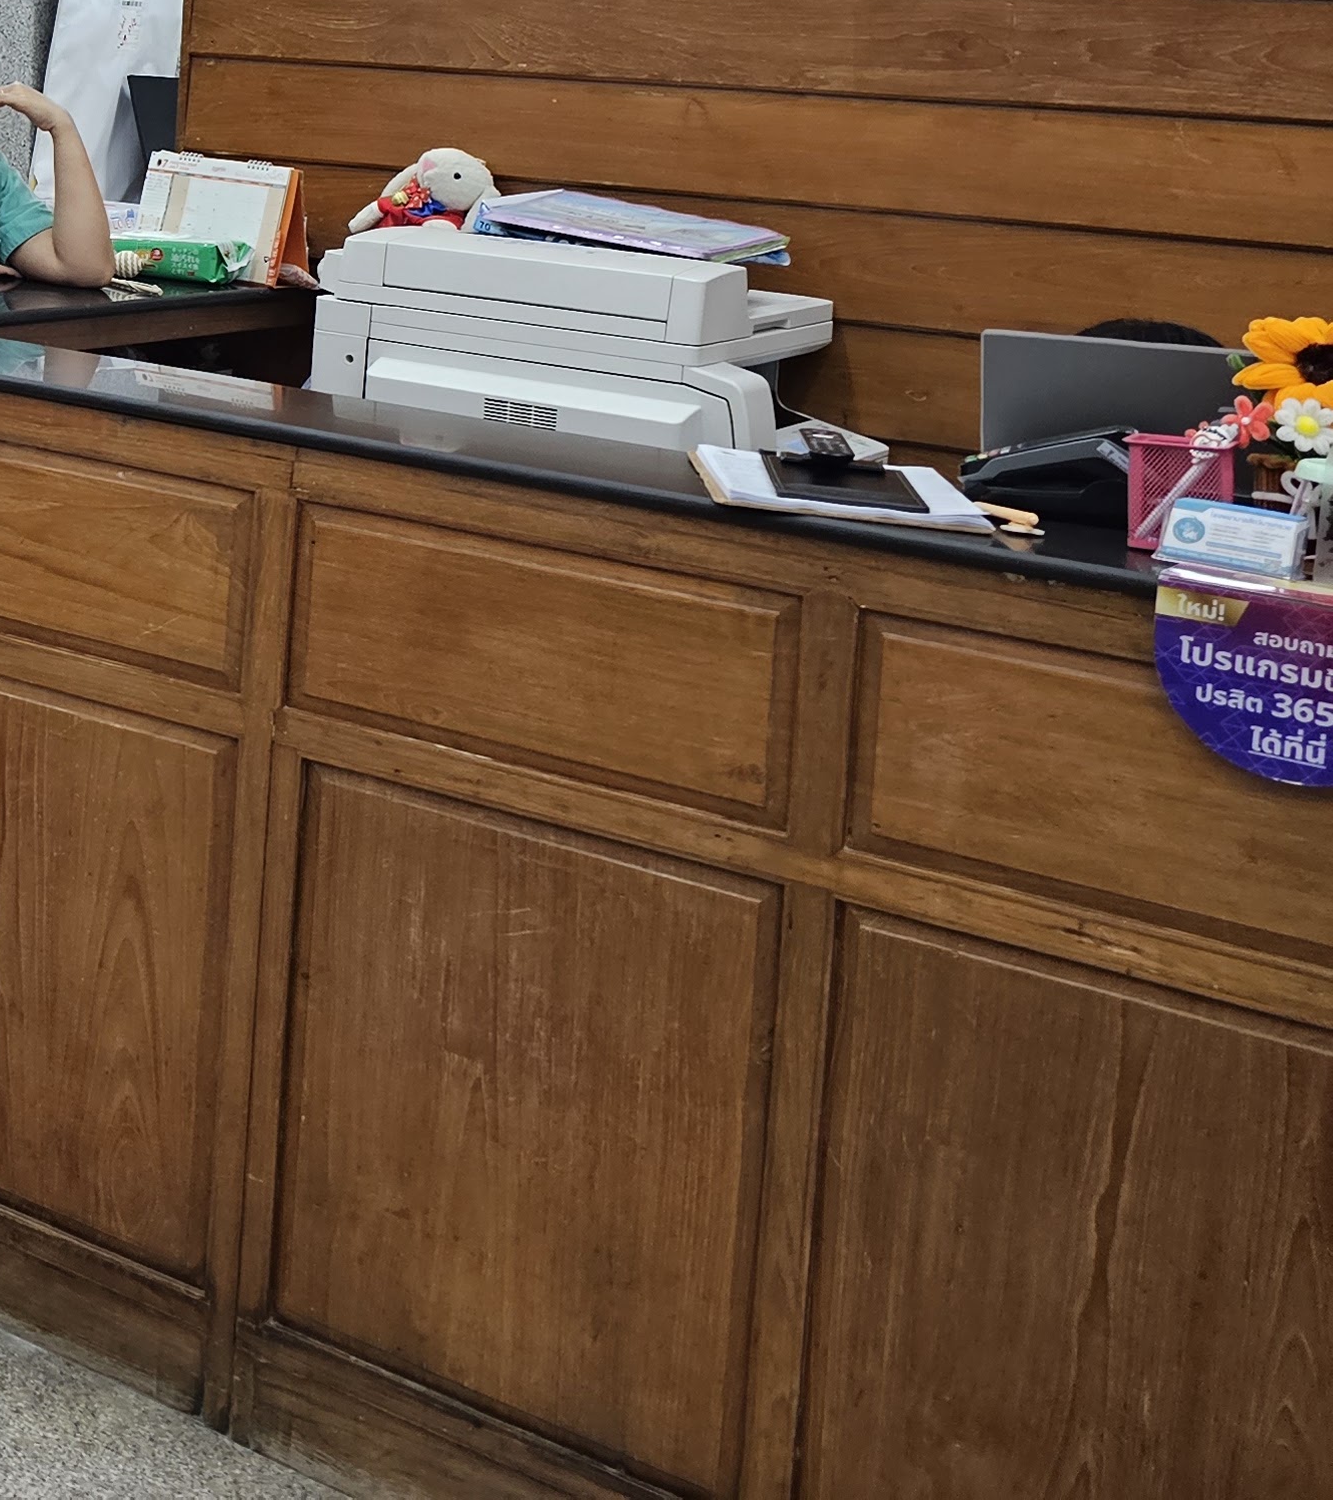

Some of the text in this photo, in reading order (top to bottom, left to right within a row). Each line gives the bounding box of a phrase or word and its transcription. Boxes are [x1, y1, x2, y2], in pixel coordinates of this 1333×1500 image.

[479, 220, 491, 232] 70
[1177, 593, 1226, 622] ใหม่!
[1195, 683, 1333, 728] ปรสิต 365
[1249, 725, 1327, 765] ได้ที่นี่
